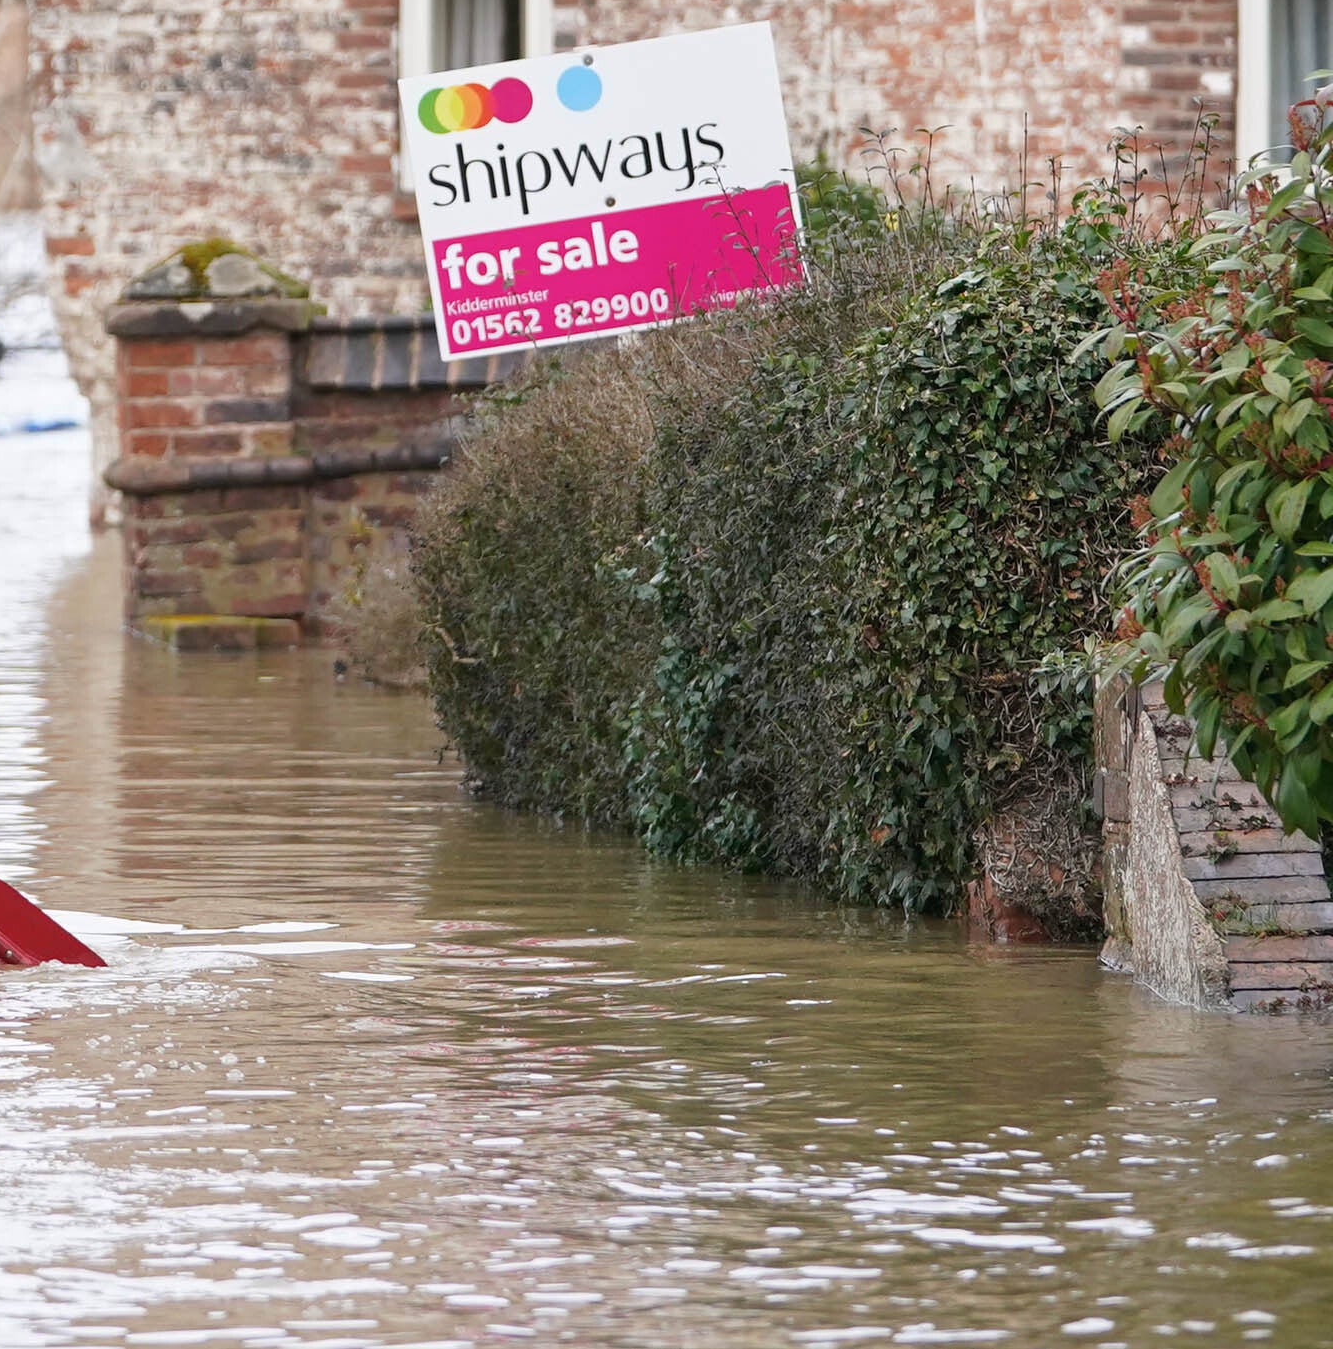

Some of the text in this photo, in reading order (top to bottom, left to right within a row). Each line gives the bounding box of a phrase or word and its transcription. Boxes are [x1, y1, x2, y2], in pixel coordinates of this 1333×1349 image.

[428, 123, 724, 215] shipways
[441, 221, 639, 289] for sale
[446, 289, 549, 316] Kidderminster
[451, 308, 543, 345] 01562
[553, 287, 670, 329] 829900
